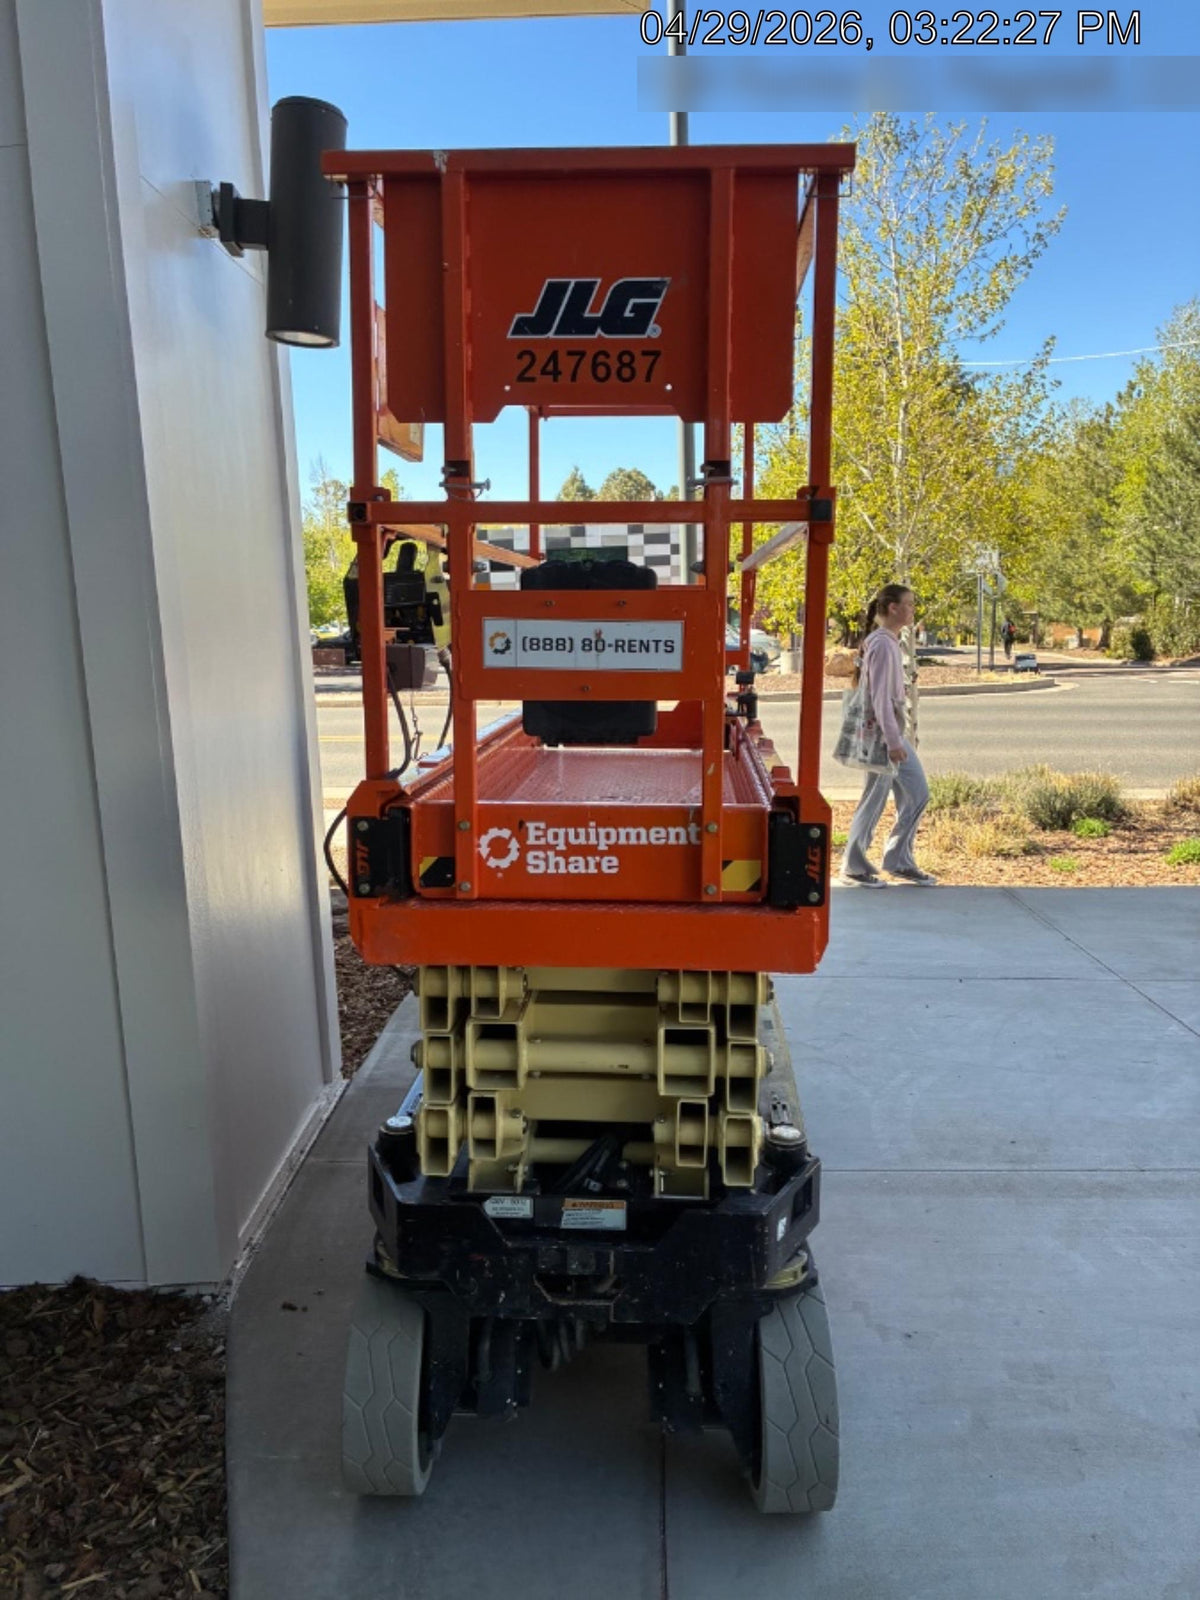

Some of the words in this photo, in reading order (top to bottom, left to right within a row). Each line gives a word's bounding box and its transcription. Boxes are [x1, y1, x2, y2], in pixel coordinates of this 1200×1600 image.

[515, 350, 662, 383] 247687
[521, 636, 574, 653] (888)
[580, 637, 675, 653] 80-RENTS
[525, 821, 701, 850] Equipment
[525, 850, 620, 874] Share
